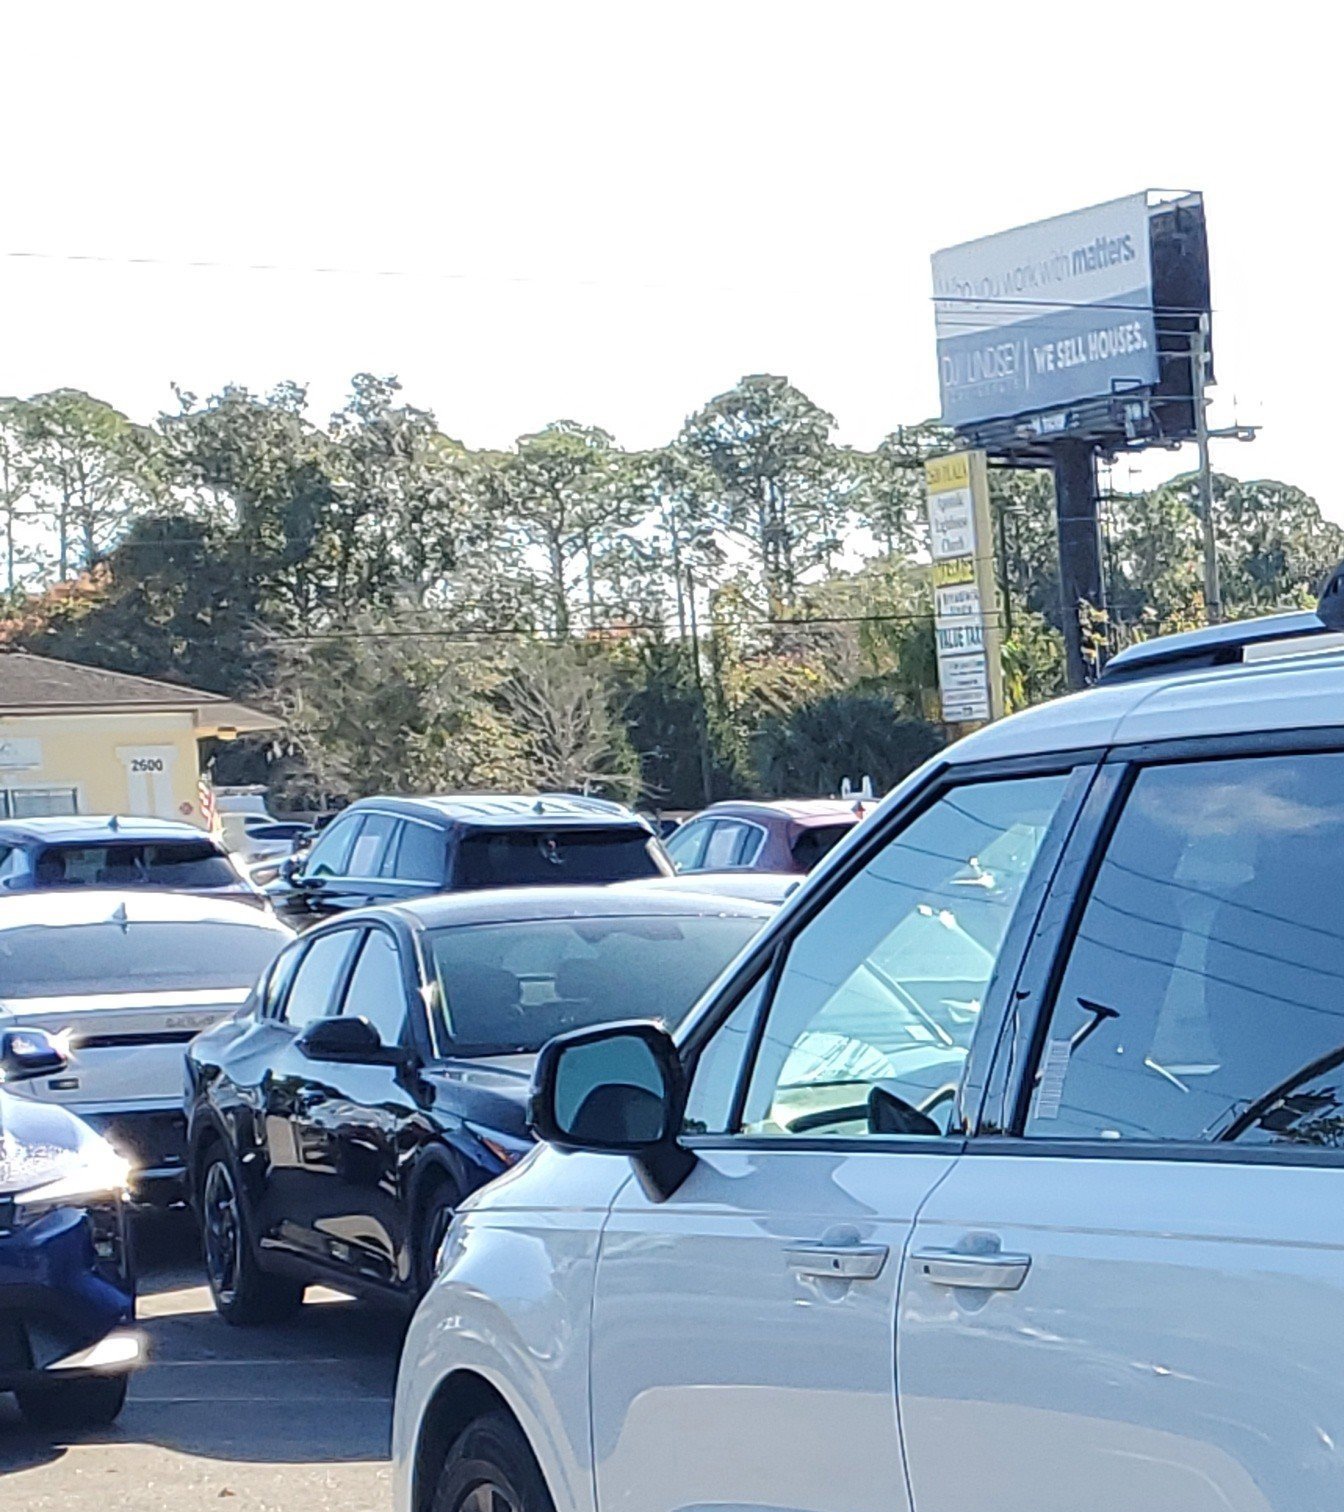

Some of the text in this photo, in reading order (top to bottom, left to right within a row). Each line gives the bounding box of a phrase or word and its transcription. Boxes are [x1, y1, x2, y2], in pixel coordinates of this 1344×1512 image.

[1033, 343, 1055, 374] WE
[1056, 336, 1087, 369] SELL
[131, 759, 163, 771] 2600
